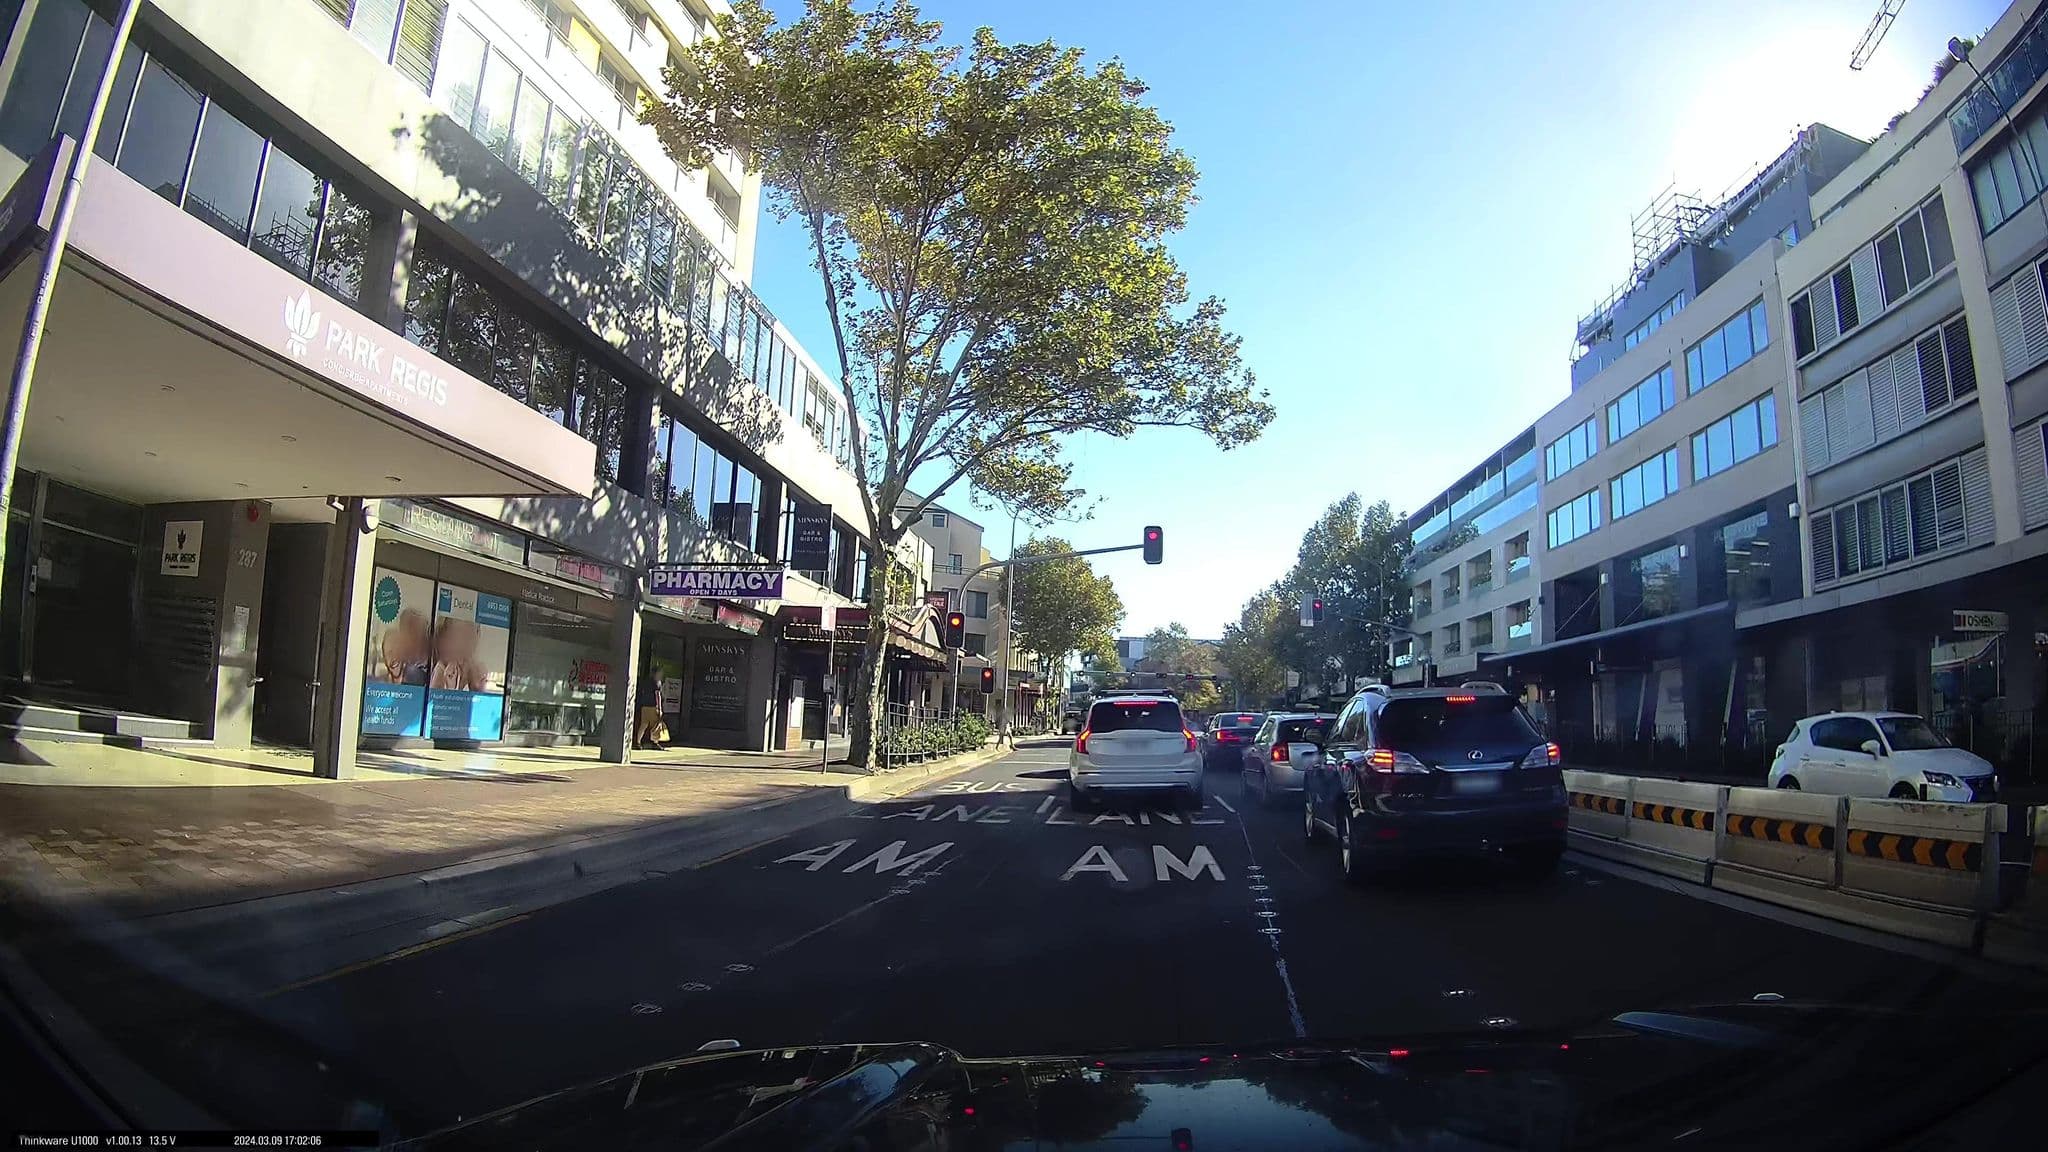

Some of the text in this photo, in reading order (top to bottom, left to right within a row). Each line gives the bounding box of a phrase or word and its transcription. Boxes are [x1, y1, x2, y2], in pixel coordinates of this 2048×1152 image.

[325, 319, 449, 407] PARK REGIS
[239, 549, 258, 568] 287
[653, 572, 780, 590] PHARMACY
[808, 627, 853, 640] MINKYS
[702, 644, 745, 655] MINSKYS
[709, 665, 734, 674] BAR &
[705, 675, 737, 684] BISTRO
[366, 687, 391, 699] Everyone
[375, 705, 392, 717] accept
[935, 781, 1025, 793] BUS
[773, 838, 955, 877] AM
[1059, 844, 1227, 882] AM
